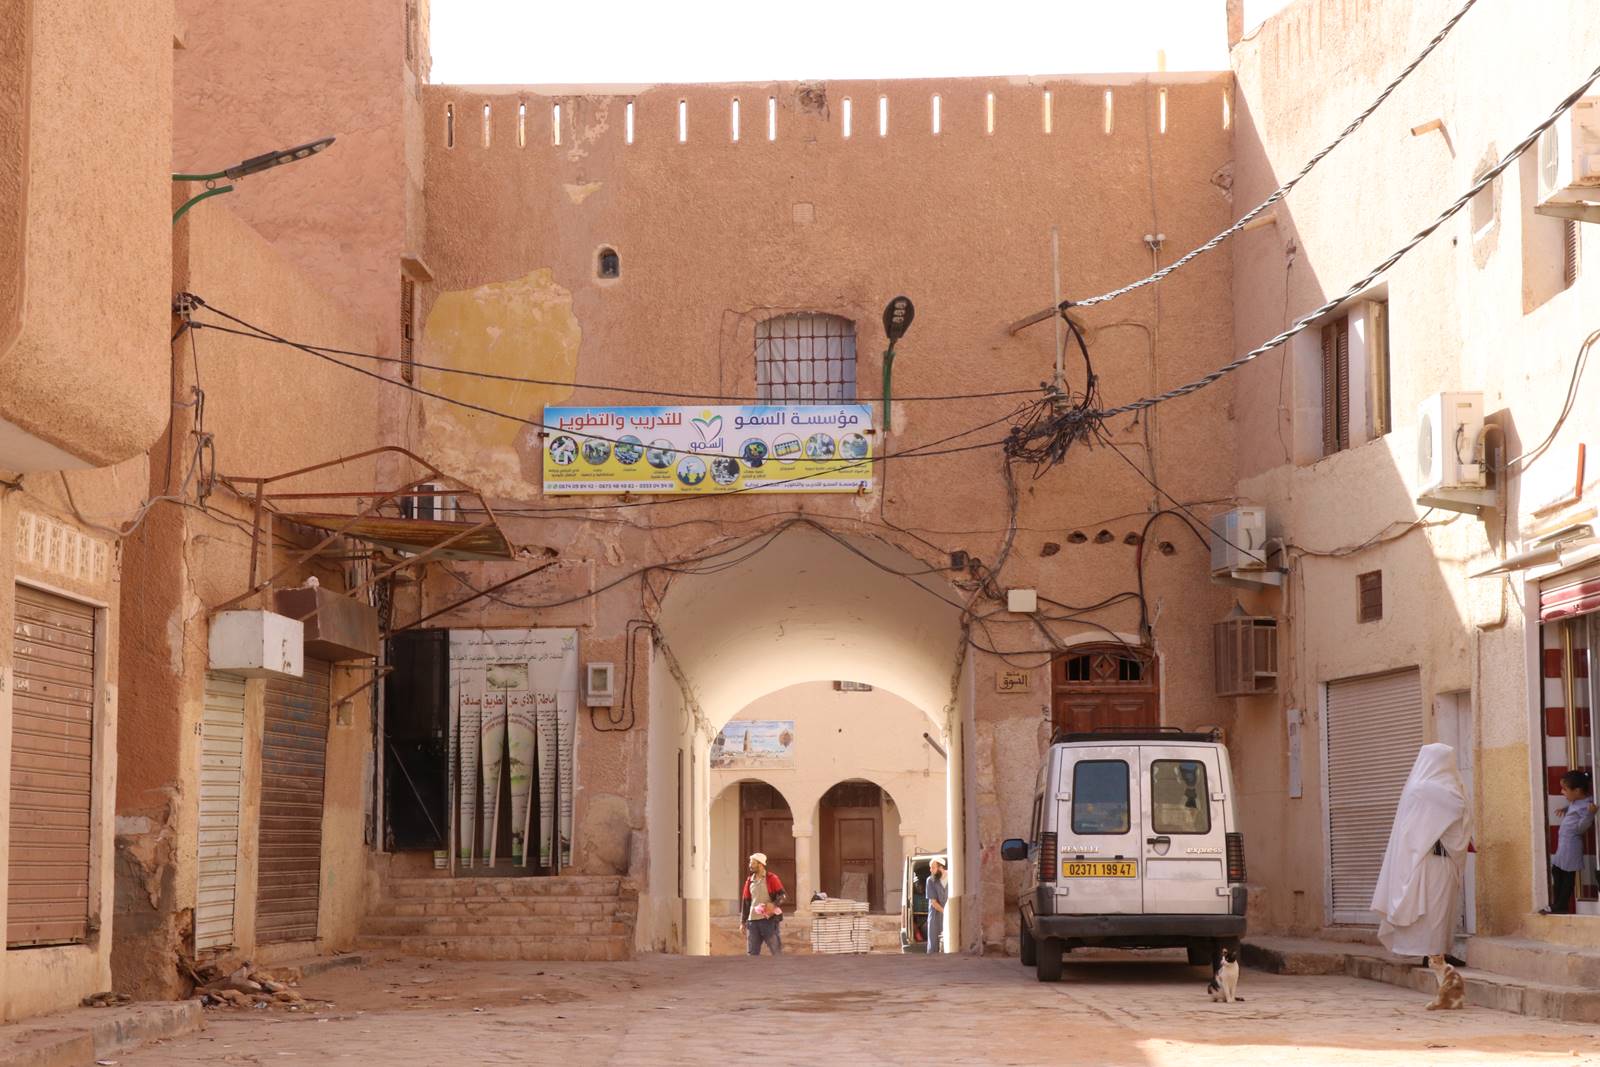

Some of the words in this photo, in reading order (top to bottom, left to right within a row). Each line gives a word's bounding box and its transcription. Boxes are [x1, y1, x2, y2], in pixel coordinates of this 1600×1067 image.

[559, 411, 625, 431] والتطوير
[630, 412, 682, 430] للتدريب
[734, 412, 785, 430] السمو
[790, 410, 858, 429] مؤسسة
[690, 437, 724, 452] السمو
[999, 673, 1028, 690] السوق
[1069, 864, 1097, 876] 02371
[1102, 863, 1118, 875] 199
[1120, 863, 1132, 875] 47
